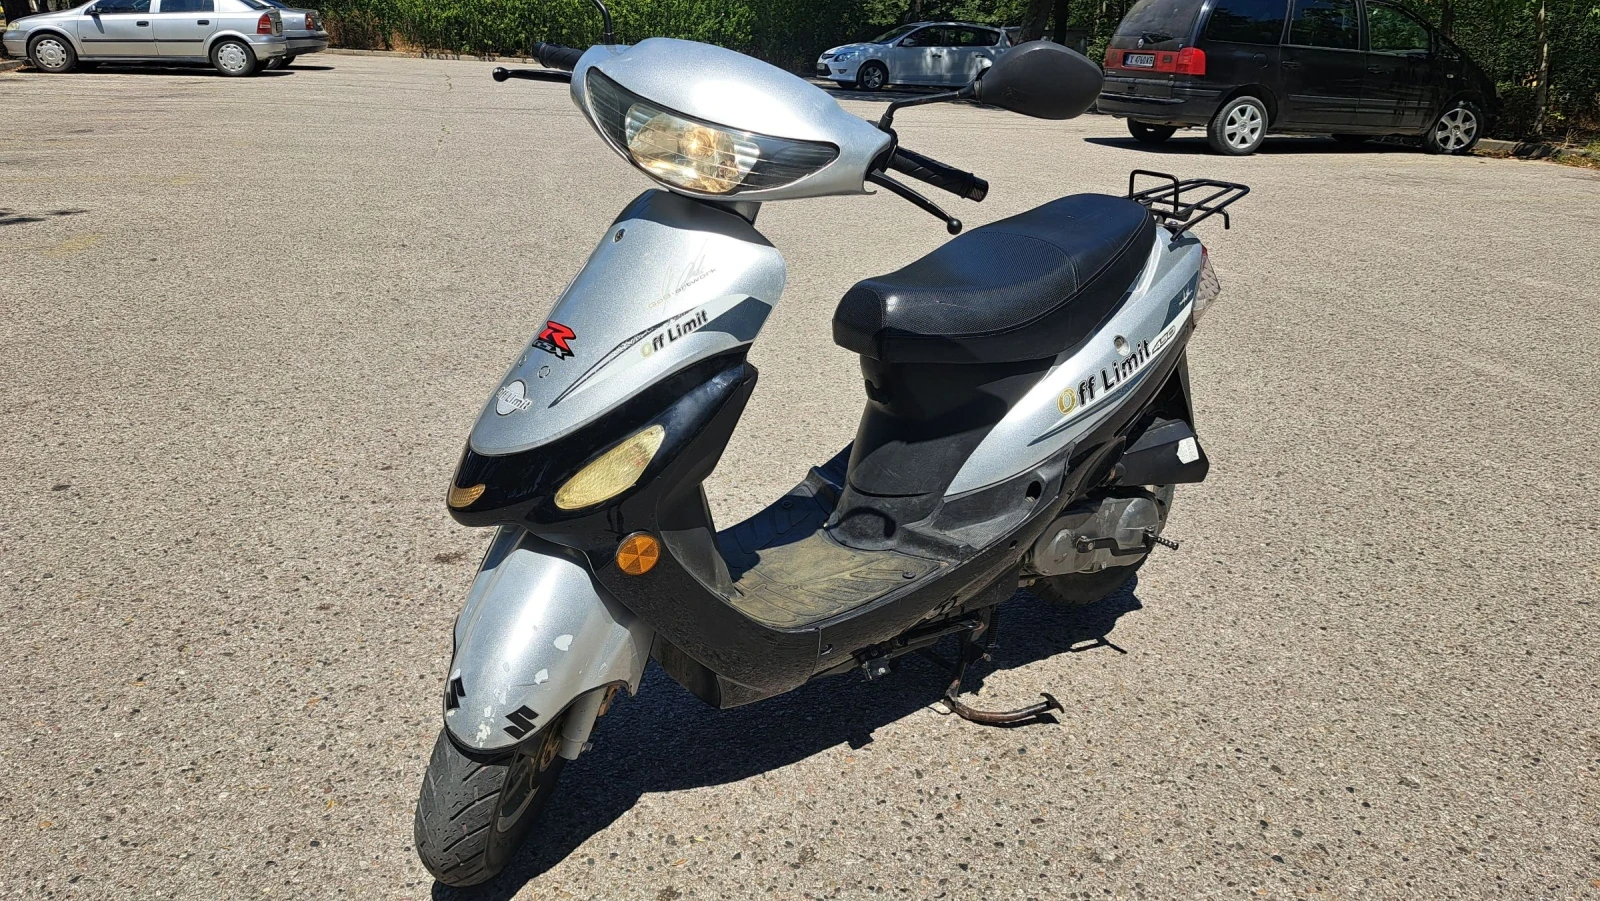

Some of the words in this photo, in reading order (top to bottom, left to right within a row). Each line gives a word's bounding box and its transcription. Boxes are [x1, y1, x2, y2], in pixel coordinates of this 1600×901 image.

[539, 320, 576, 352] R
[641, 332, 664, 357] Off
[667, 309, 708, 342] Limit
[1057, 375, 1095, 414] Off
[1100, 337, 1151, 393] Limit
